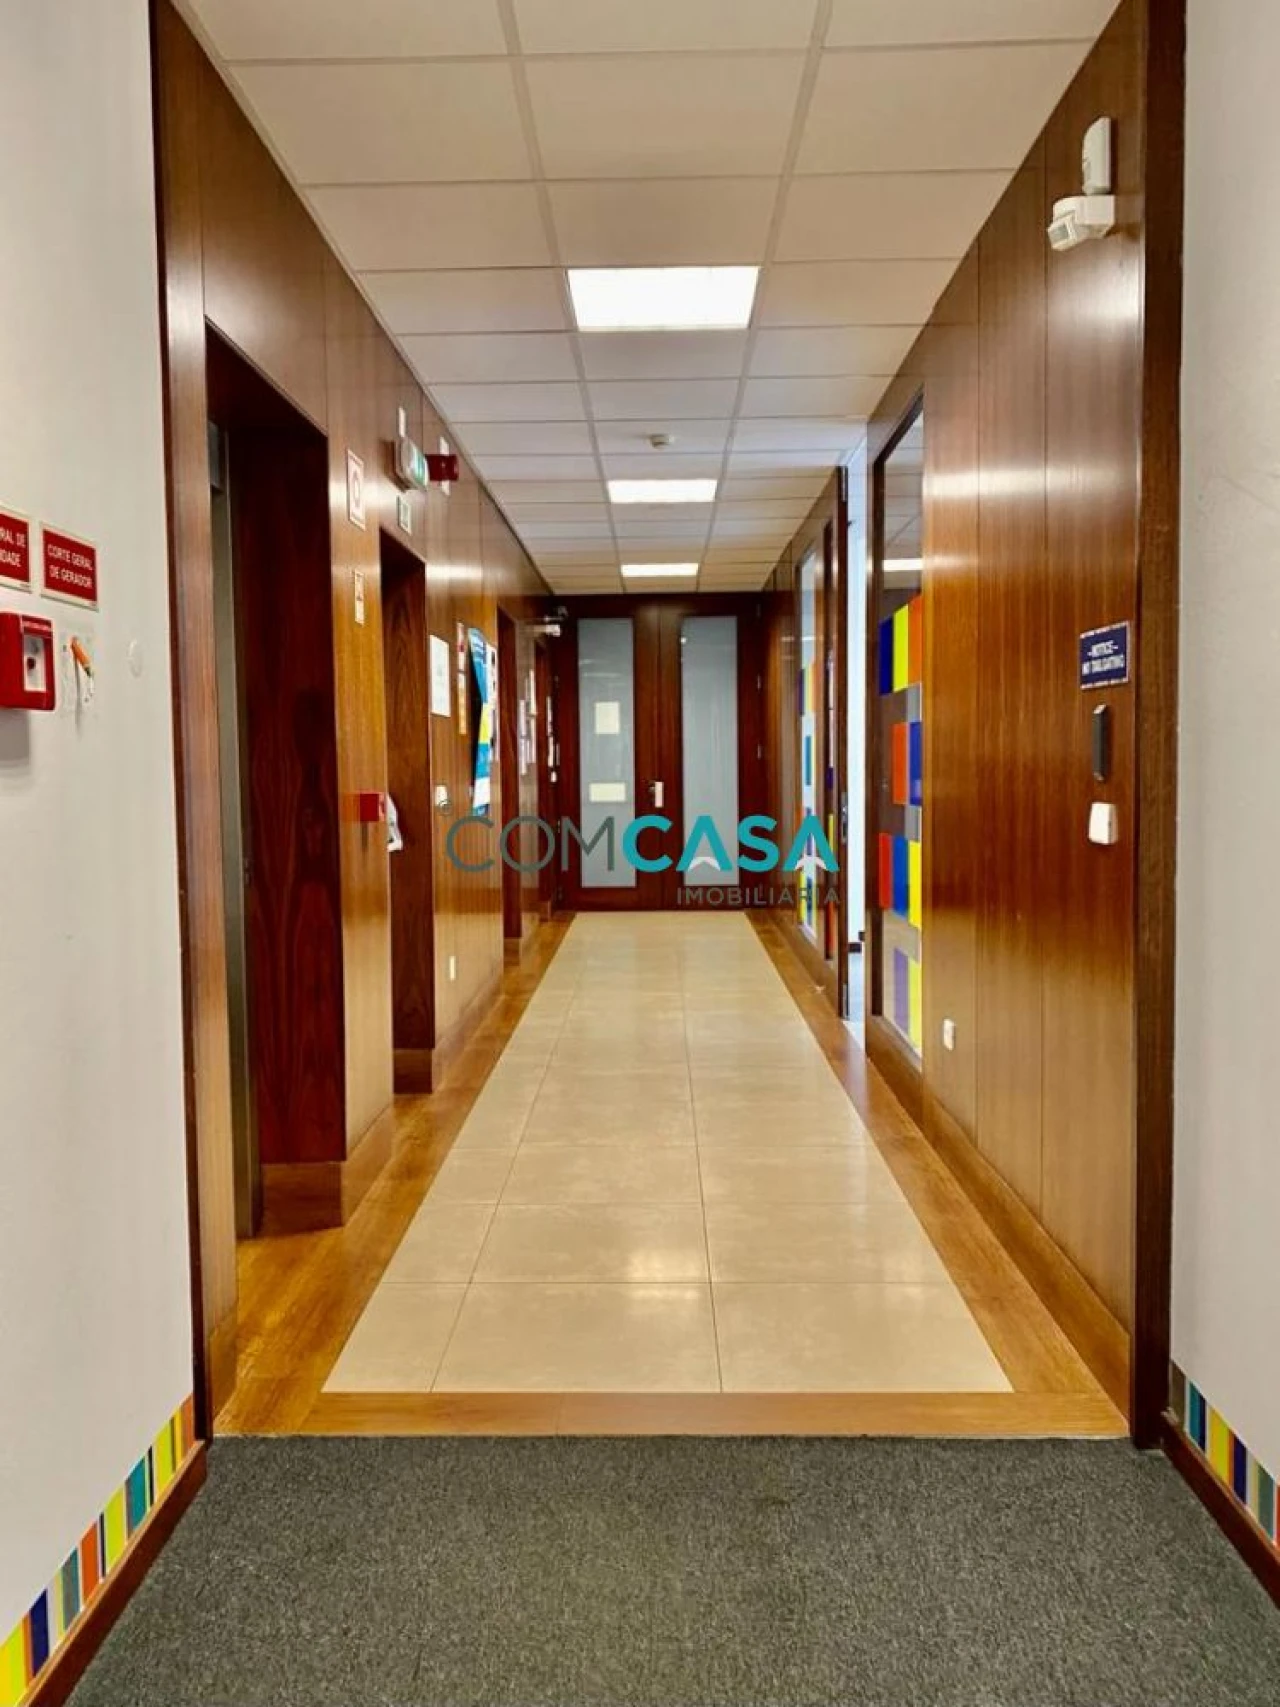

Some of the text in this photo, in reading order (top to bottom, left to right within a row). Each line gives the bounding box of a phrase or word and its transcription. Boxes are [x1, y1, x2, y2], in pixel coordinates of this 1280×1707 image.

[47, 543, 93, 571] CORTE GERAL
[49, 564, 93, 589] DE GERADOR
